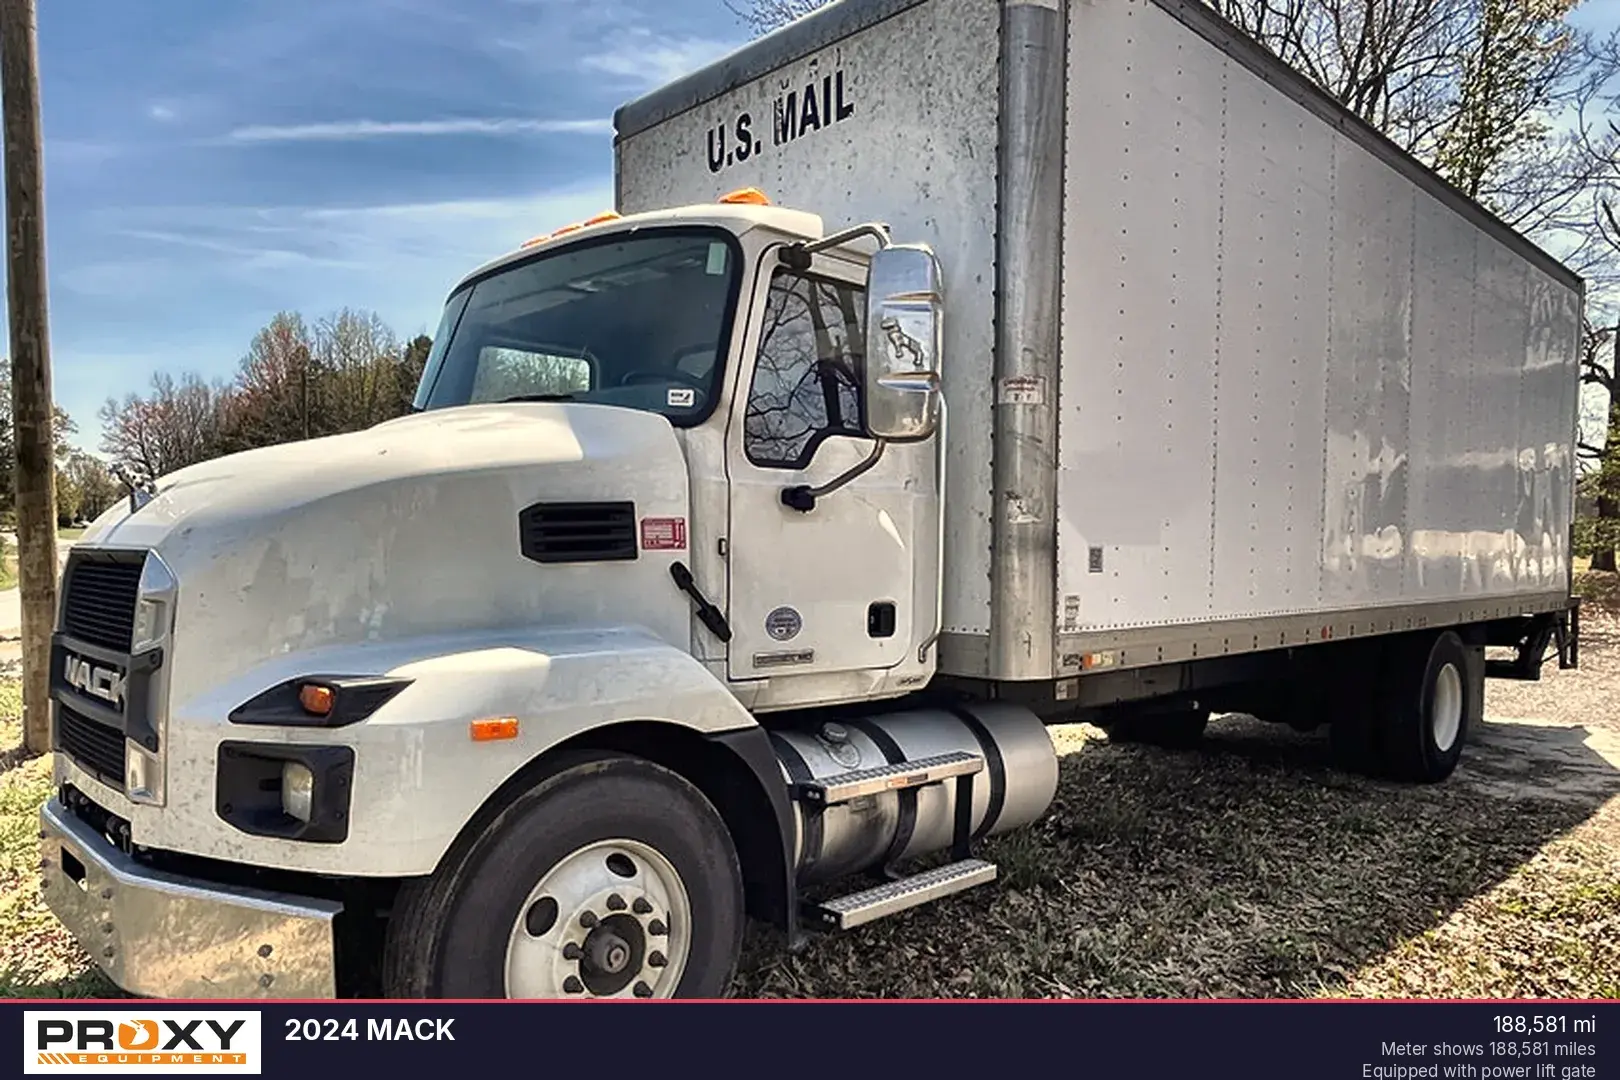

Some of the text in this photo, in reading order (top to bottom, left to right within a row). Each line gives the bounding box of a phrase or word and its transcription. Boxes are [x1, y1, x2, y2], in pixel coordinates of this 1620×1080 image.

[706, 69, 855, 174] U.S. MAIL
[64, 654, 126, 704] MACK
